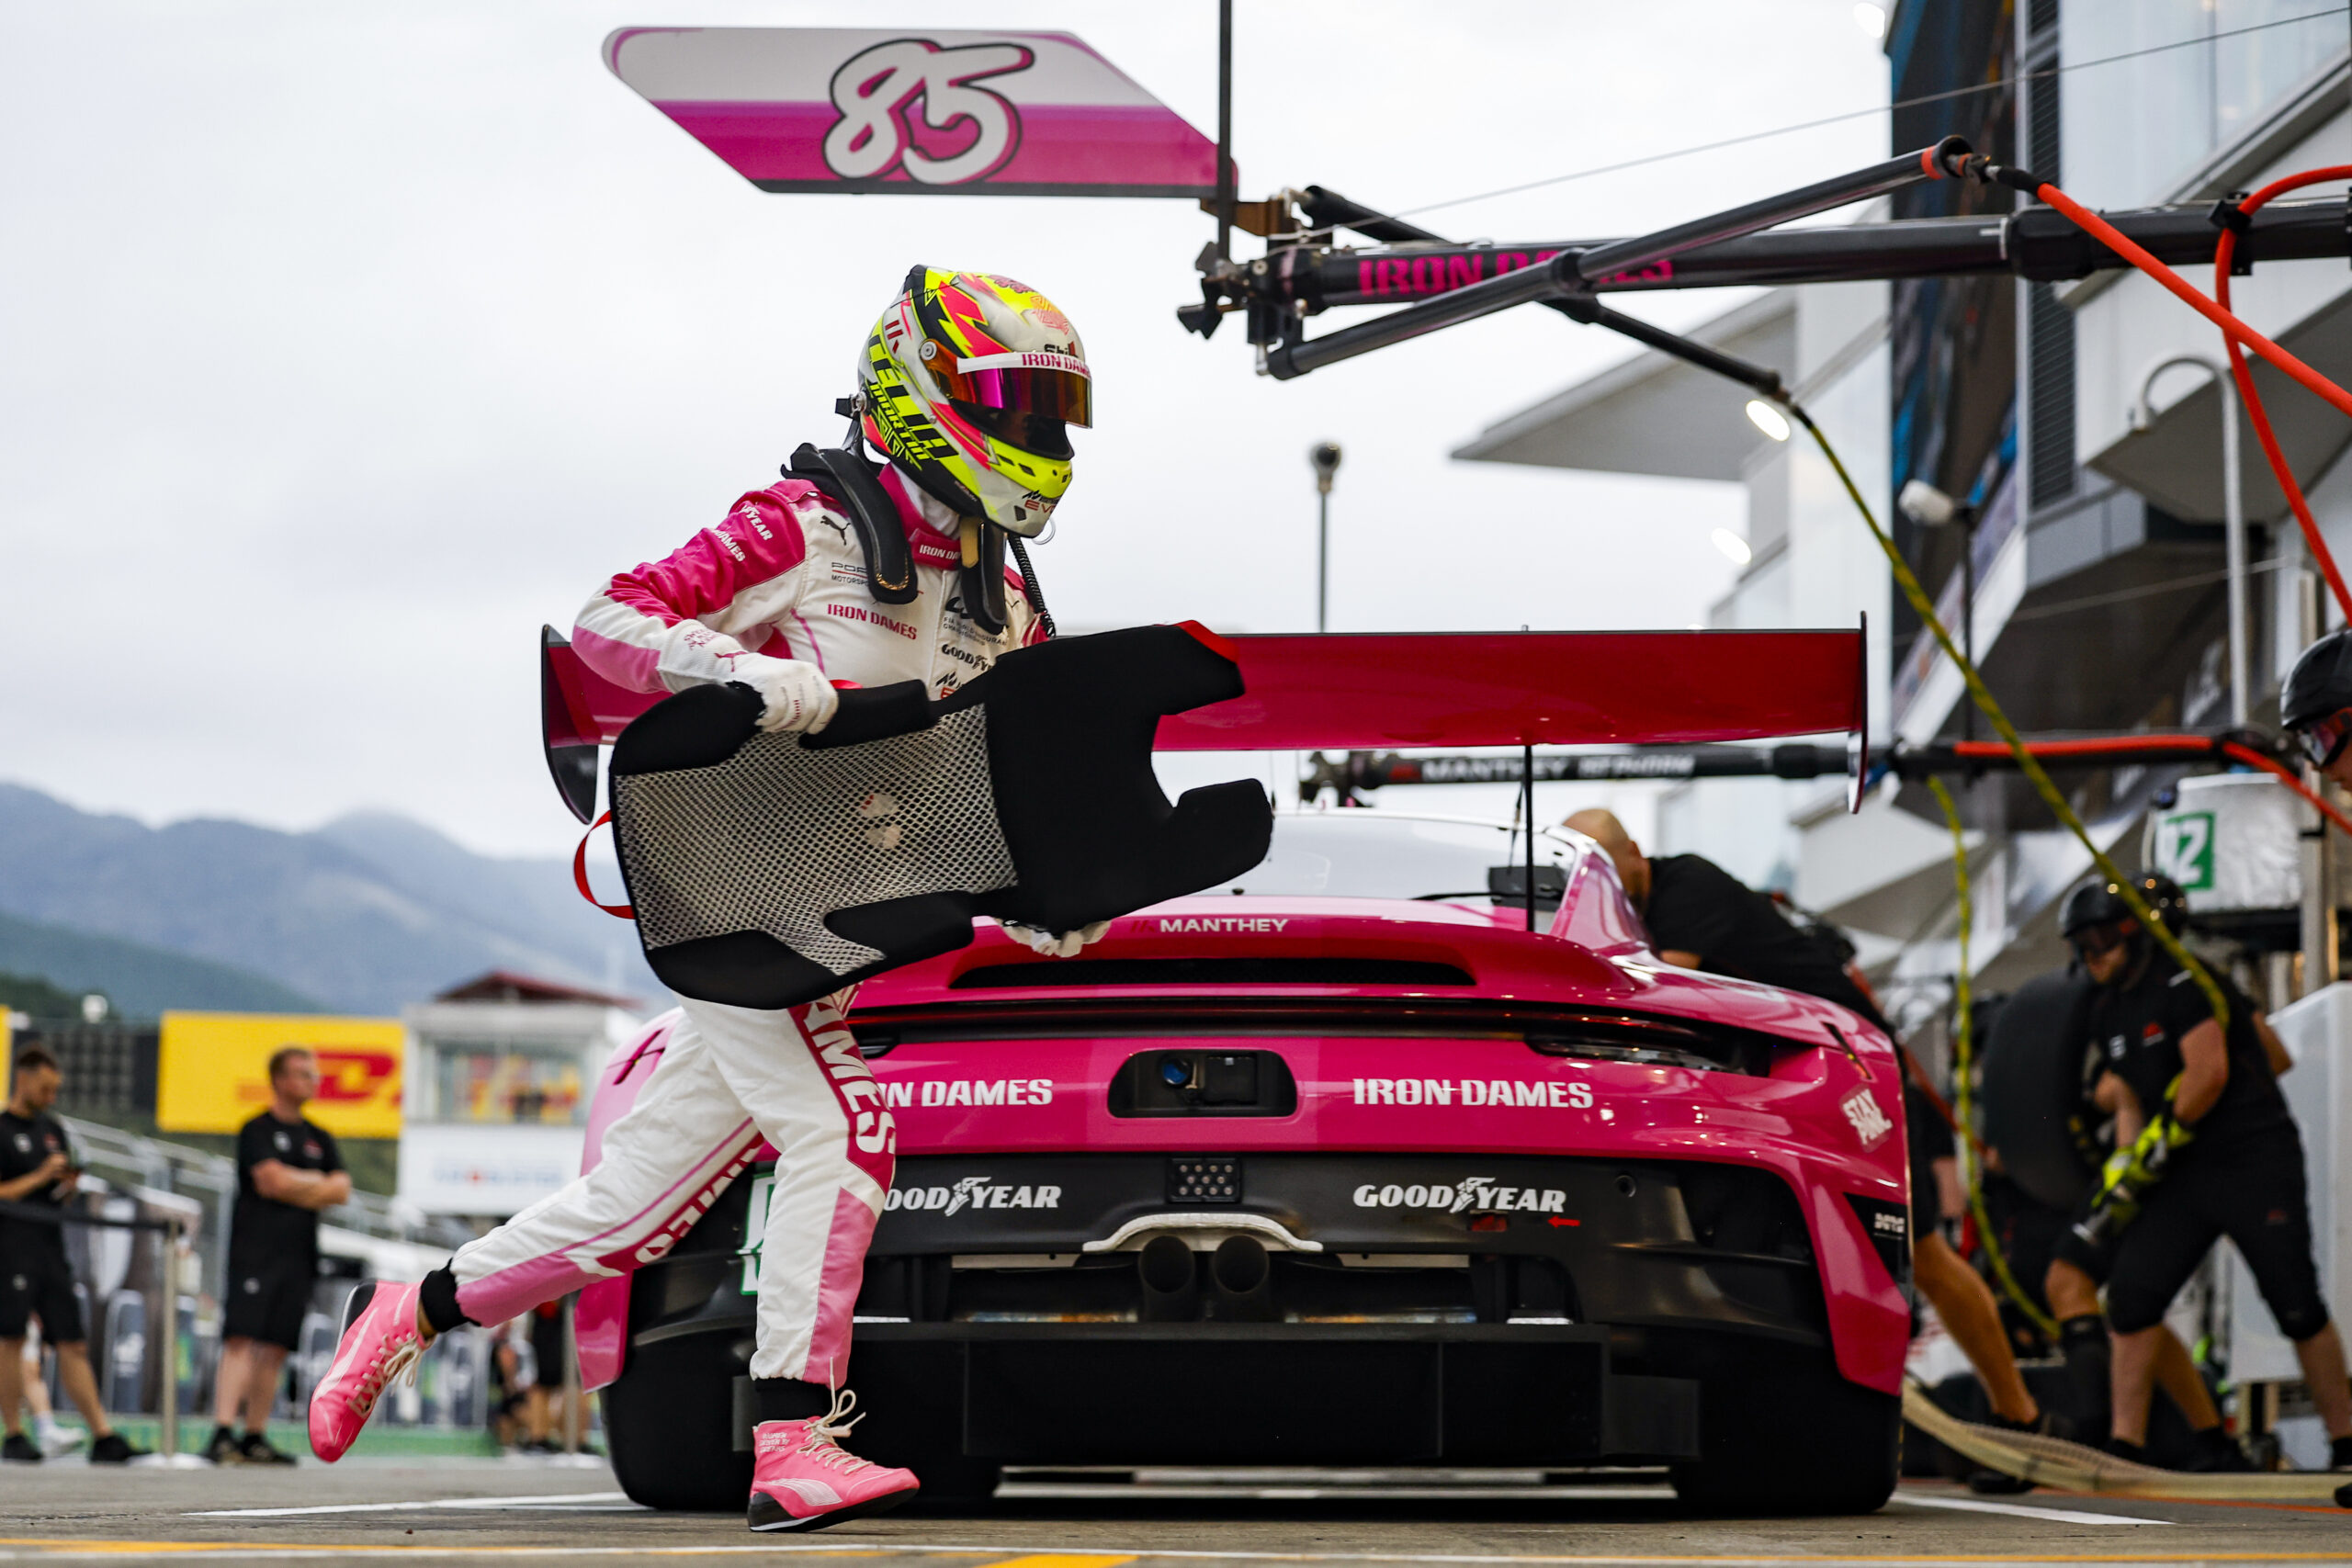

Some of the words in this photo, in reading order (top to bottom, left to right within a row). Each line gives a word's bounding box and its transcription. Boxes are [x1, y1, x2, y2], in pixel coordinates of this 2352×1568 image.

[820, 39, 1035, 185] 85
[1358, 252, 1484, 296] IRON
[1022, 353, 1061, 367] IRON
[919, 544, 946, 558] IRON
[827, 604, 867, 622] IRON
[870, 611, 917, 640] DAMES
[1159, 919, 1288, 933] MANTHEY
[921, 1078, 1054, 1108] DAMES
[1353, 1077, 1452, 1106] IRON
[1461, 1079, 1593, 1109] DAMES
[883, 1184, 1062, 1213] OODYEAR
